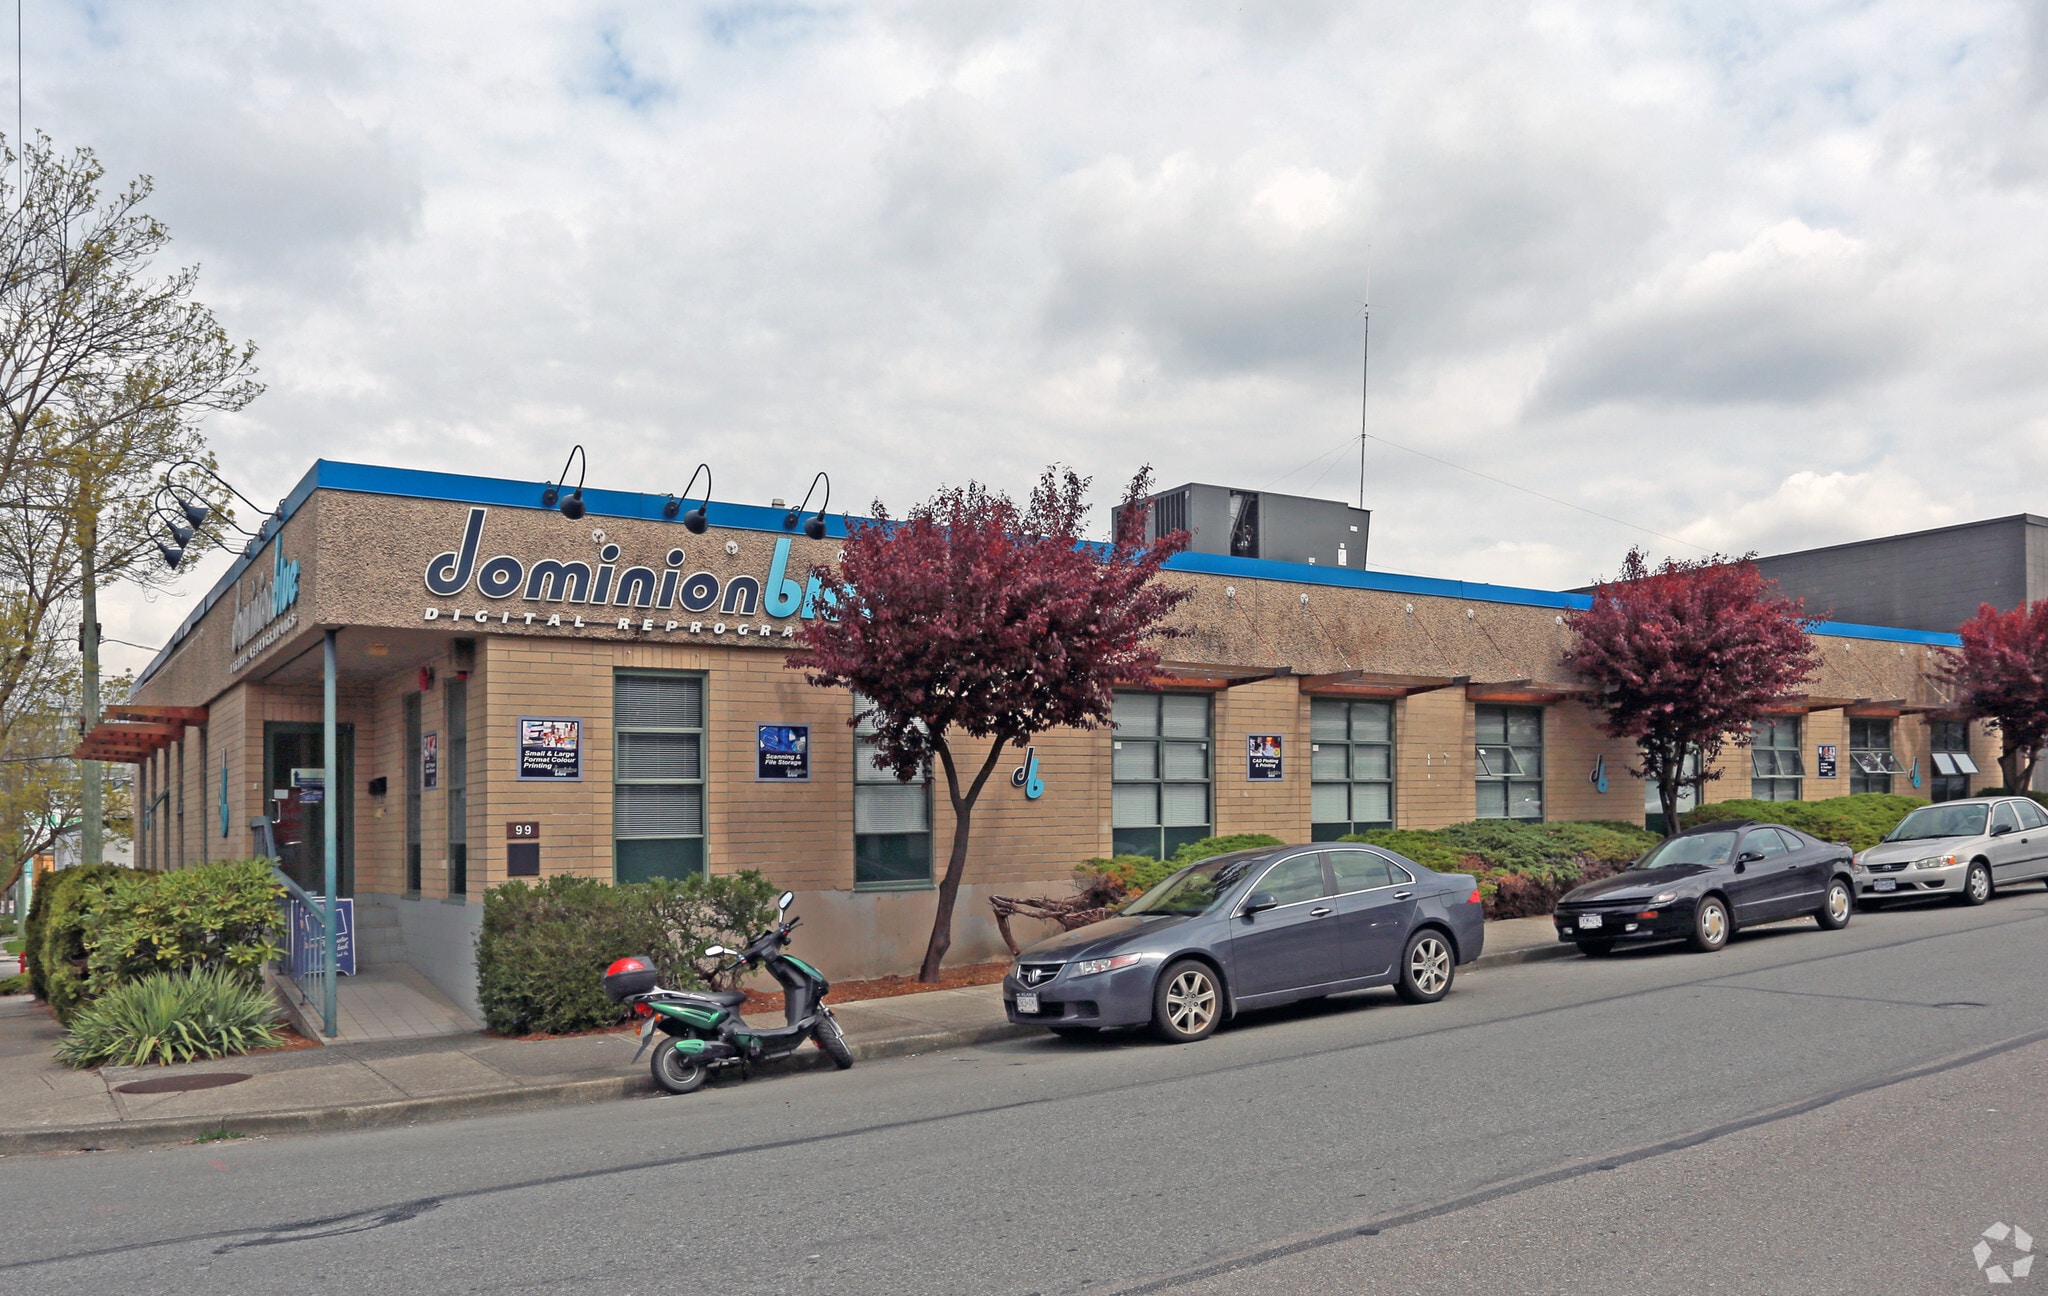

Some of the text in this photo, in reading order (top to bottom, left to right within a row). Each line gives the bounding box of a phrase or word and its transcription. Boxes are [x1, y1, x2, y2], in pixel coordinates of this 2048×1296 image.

[424, 607, 794, 638] DIGITAL REPROGRA
[515, 825, 532, 835] 99
